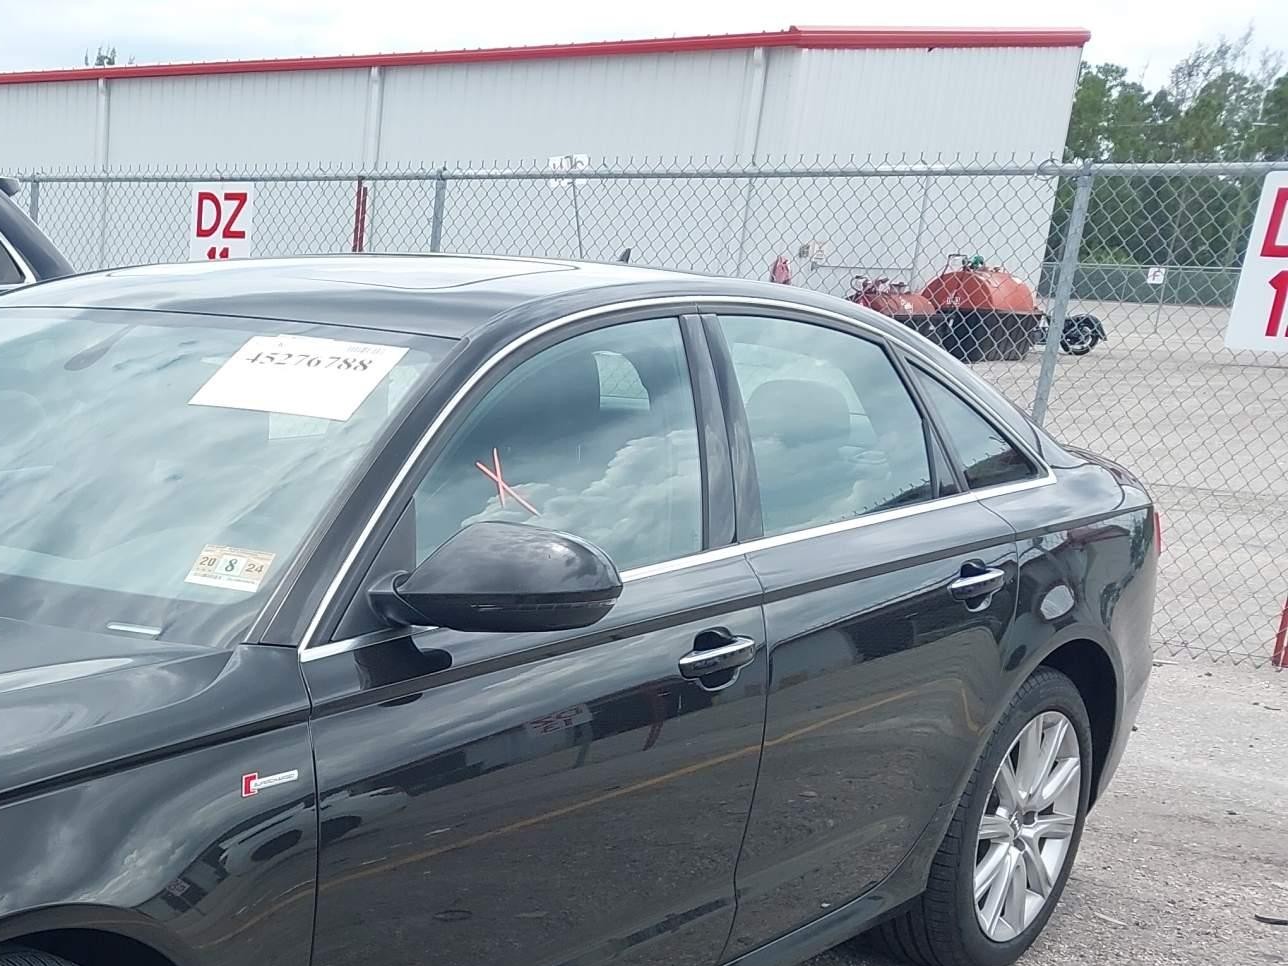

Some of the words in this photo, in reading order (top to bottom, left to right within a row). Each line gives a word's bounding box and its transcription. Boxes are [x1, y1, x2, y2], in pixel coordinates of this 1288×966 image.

[196, 191, 248, 239] DZ
[245, 351, 373, 373] 45276788
[199, 556, 217, 567] 20
[224, 558, 239, 572] 8
[245, 563, 265, 573] 24
